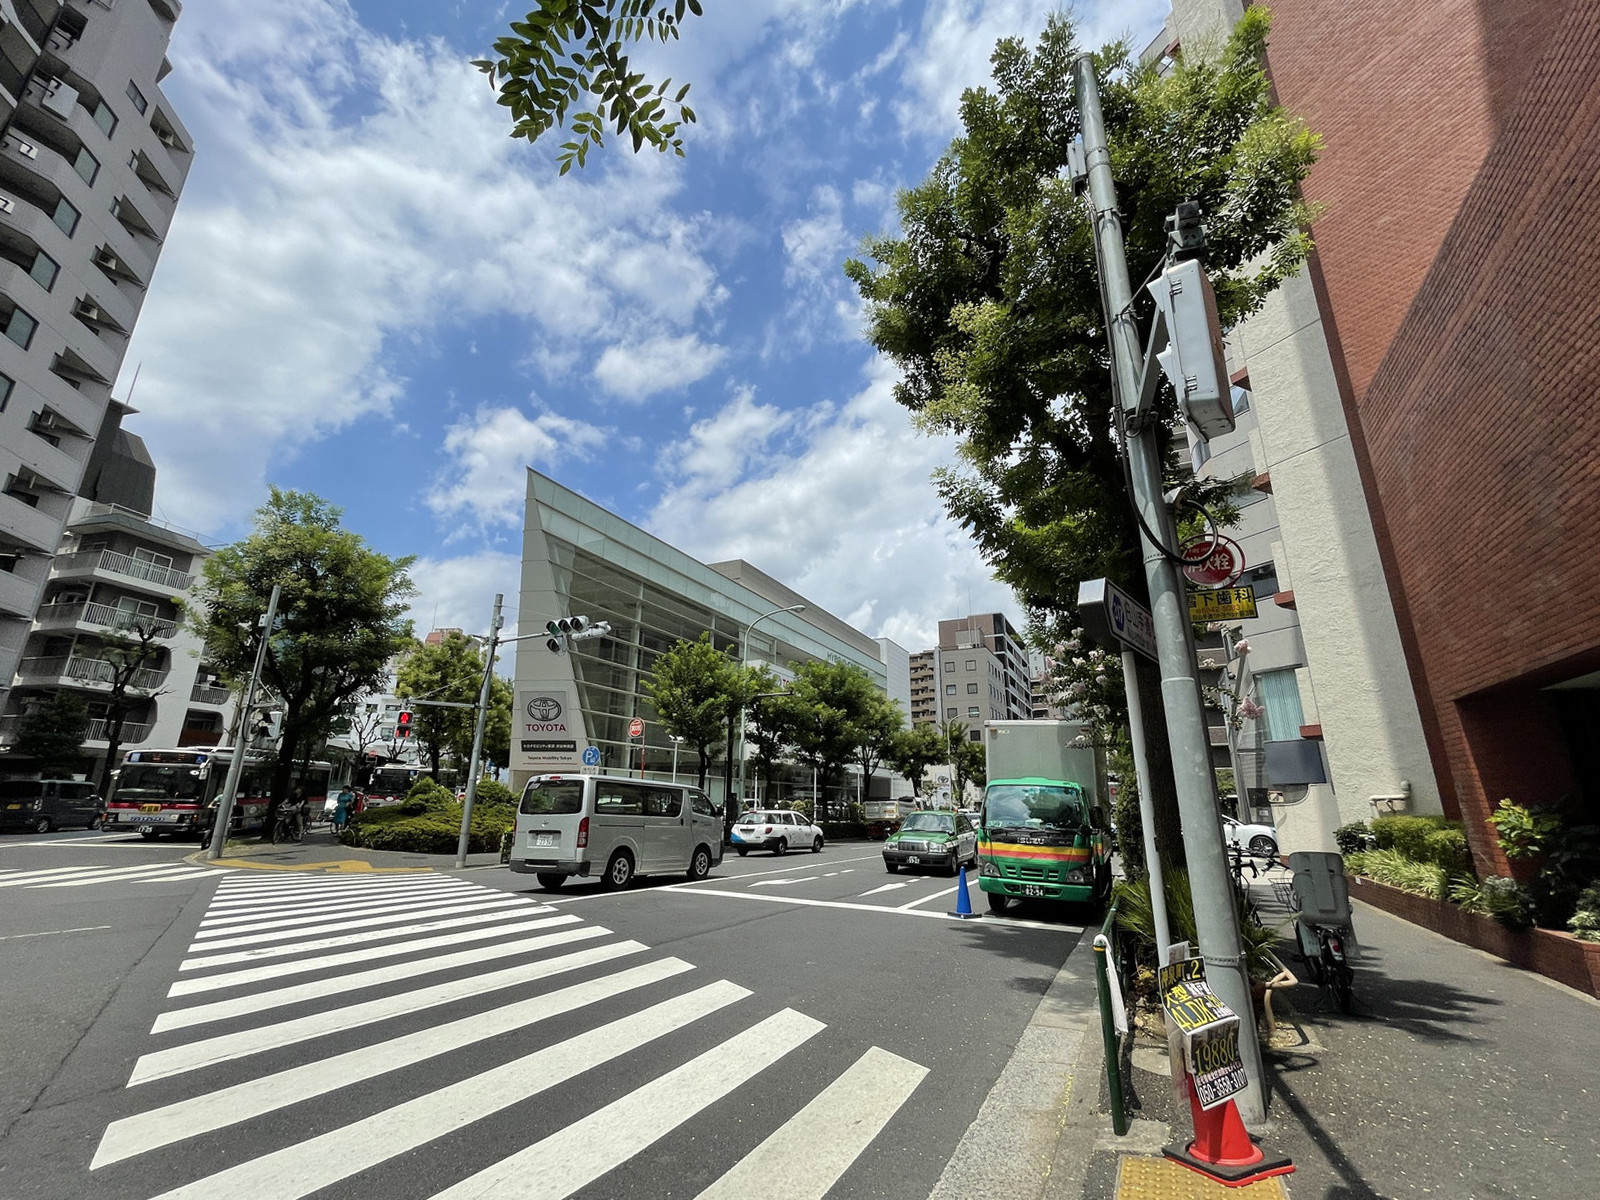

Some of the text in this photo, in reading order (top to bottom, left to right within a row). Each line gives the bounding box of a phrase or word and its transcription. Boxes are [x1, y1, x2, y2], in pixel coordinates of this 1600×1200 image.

[526, 723, 566, 732] TOYOTA
[585, 751, 593, 763] P
[1017, 837, 1045, 845] ISUZU
[1191, 960, 1201, 979] 2
[1171, 997, 1218, 1030] 4LDK
[1195, 1036, 1235, 1076] 19880
